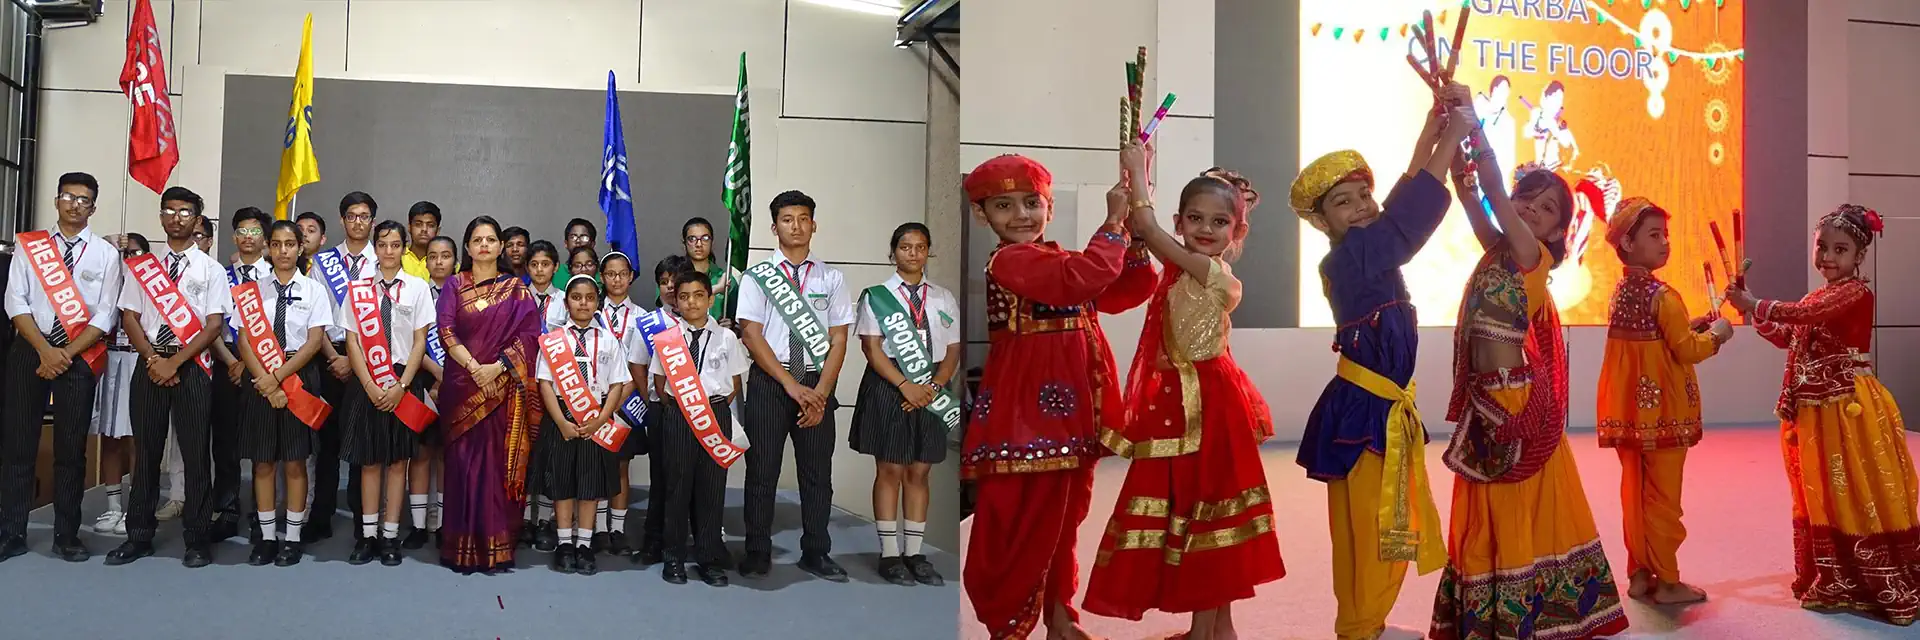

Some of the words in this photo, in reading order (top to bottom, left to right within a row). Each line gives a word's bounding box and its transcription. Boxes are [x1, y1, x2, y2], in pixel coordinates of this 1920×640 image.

[1472, 0, 1589, 23] GARBA
[1473, 39, 1536, 71] THE
[1550, 45, 1654, 79] FLOOR
[27, 238, 66, 287] HEAD
[53, 287, 87, 326] BOY
[134, 258, 192, 328] HEAD
[751, 263, 802, 316] SPORTS
[793, 312, 830, 357] HEAD
[238, 288, 267, 338] HEAD
[257, 338, 283, 374] GIR
[883, 312, 928, 373] SPORTS
[368, 345, 397, 391] GIR
[543, 336, 565, 363] JR.
[556, 361, 591, 412] HEAD
[626, 396, 649, 424] GIRL
[662, 346, 688, 375] JR.
[675, 376, 712, 431] HEAD
[702, 433, 743, 464] BOY
